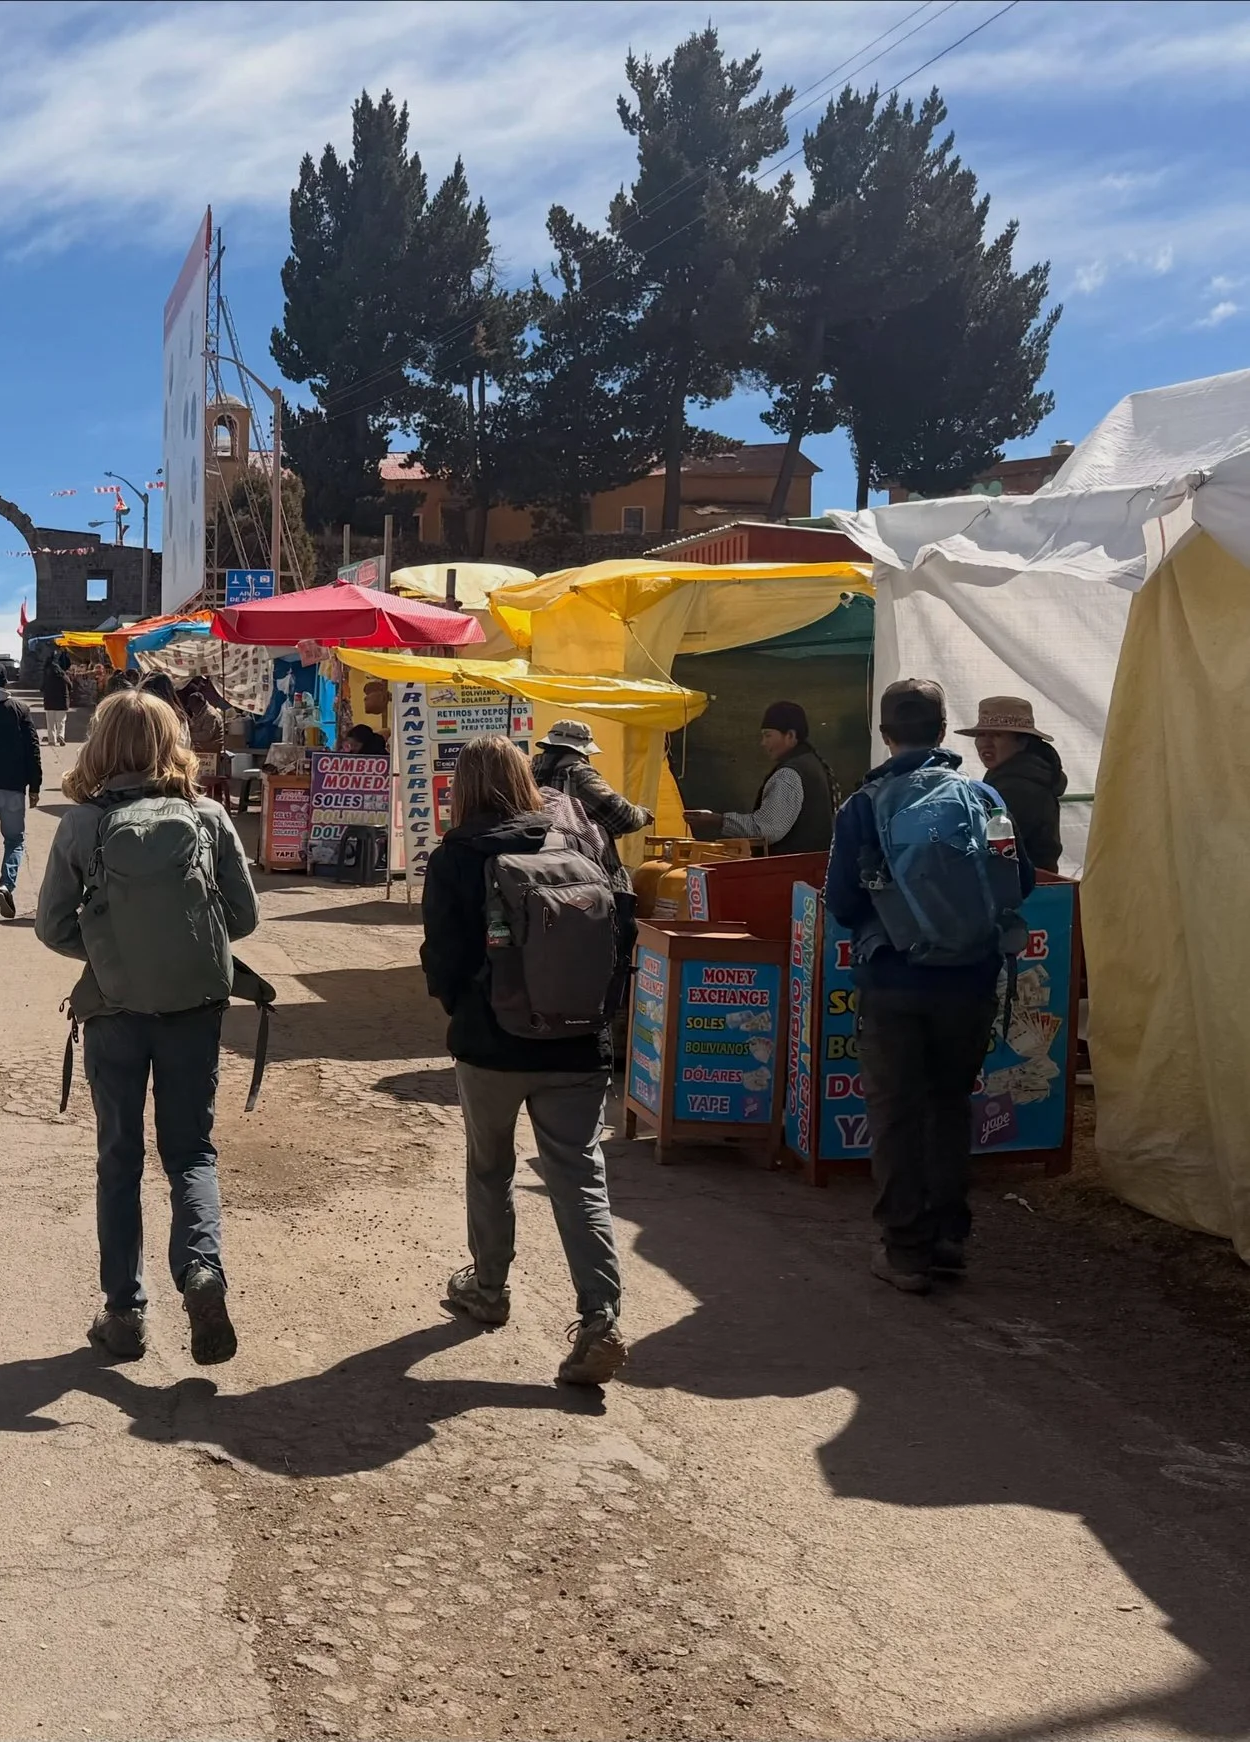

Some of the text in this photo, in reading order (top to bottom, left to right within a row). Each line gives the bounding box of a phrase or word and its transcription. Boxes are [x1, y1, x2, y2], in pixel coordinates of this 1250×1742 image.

[437, 709, 472, 718] RETIROS
[482, 707, 528, 716] DEPOSTOS
[317, 757, 388, 774] CAMBIO
[312, 793, 364, 808] SOLES
[702, 966, 757, 985] MONEY
[687, 987, 770, 1007] EXCHANGE
[686, 1016, 726, 1030] SOLES
[788, 919, 804, 1116] CAMBIO DE
[685, 1041, 751, 1056] BOLIVIANOS
[682, 1064, 743, 1083] DÓLARES
[687, 1094, 730, 1113] YAPE
[798, 1072, 811, 1154] SOLES
[981, 1112, 1011, 1144] yape
